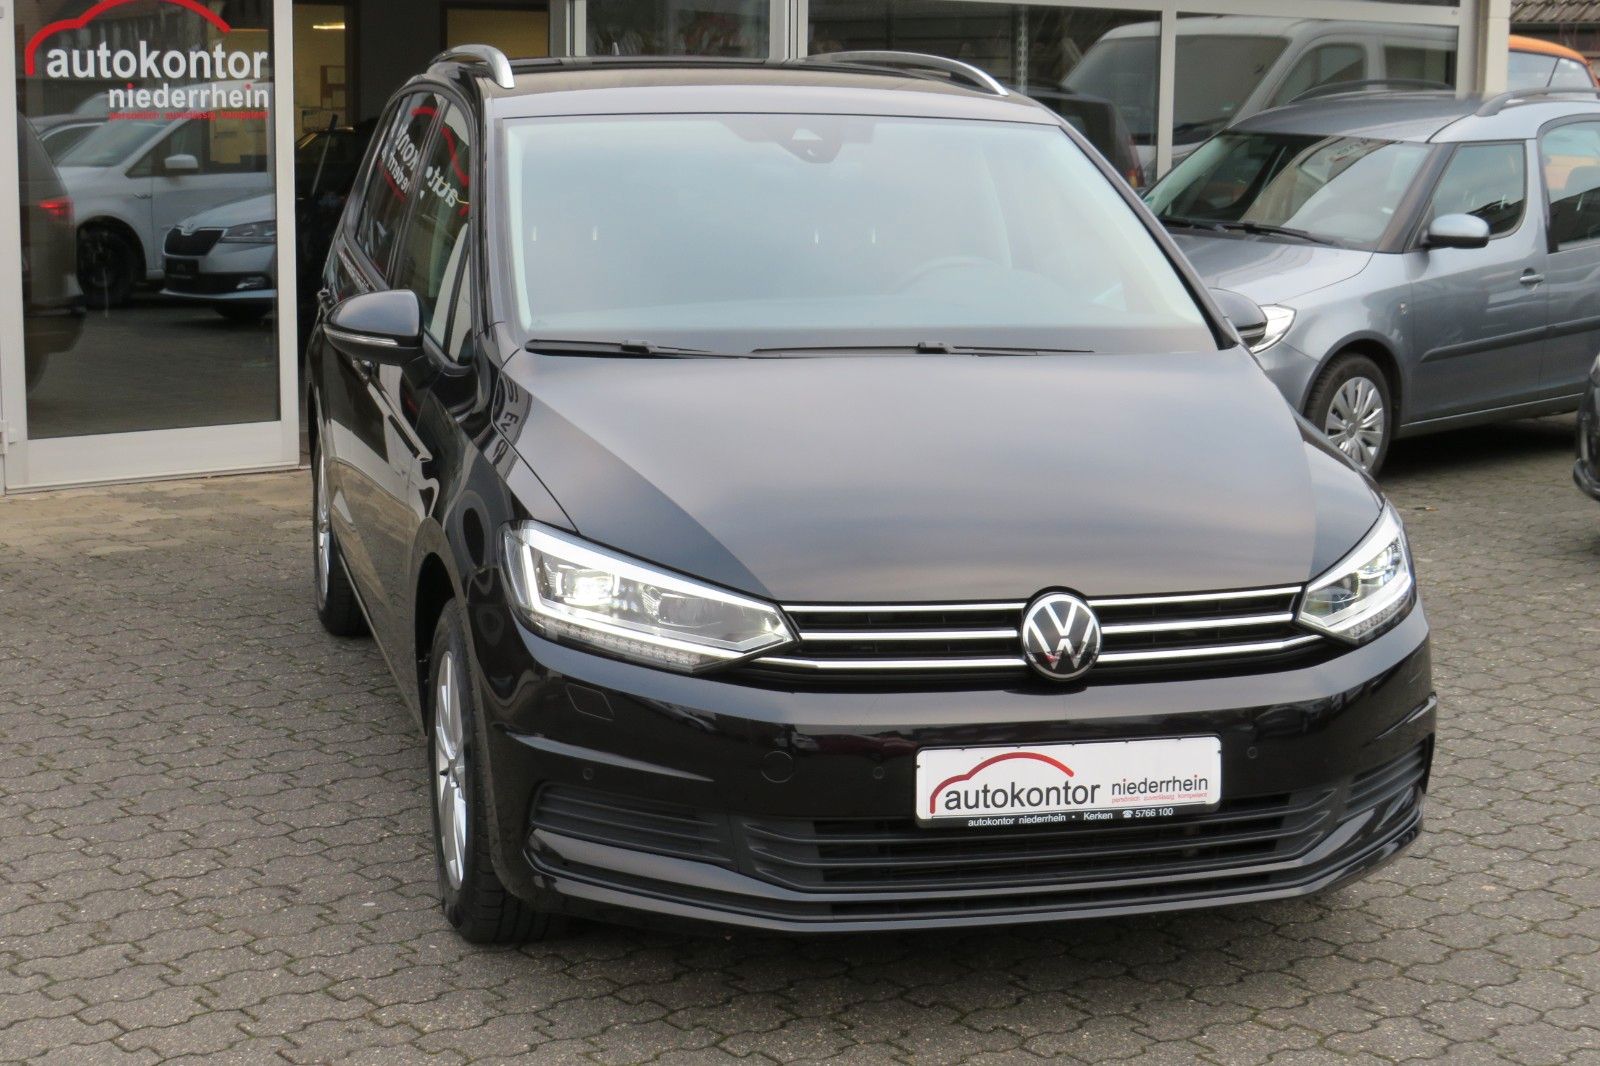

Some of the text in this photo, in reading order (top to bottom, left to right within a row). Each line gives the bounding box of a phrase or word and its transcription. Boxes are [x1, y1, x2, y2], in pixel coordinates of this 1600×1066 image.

[46, 40, 268, 79] autokontor
[109, 83, 270, 108] niederrhein
[944, 774, 1209, 811] autokontor niederrhein
[968, 807, 1174, 827] autokontor niederrhein Kerken 5766 100
